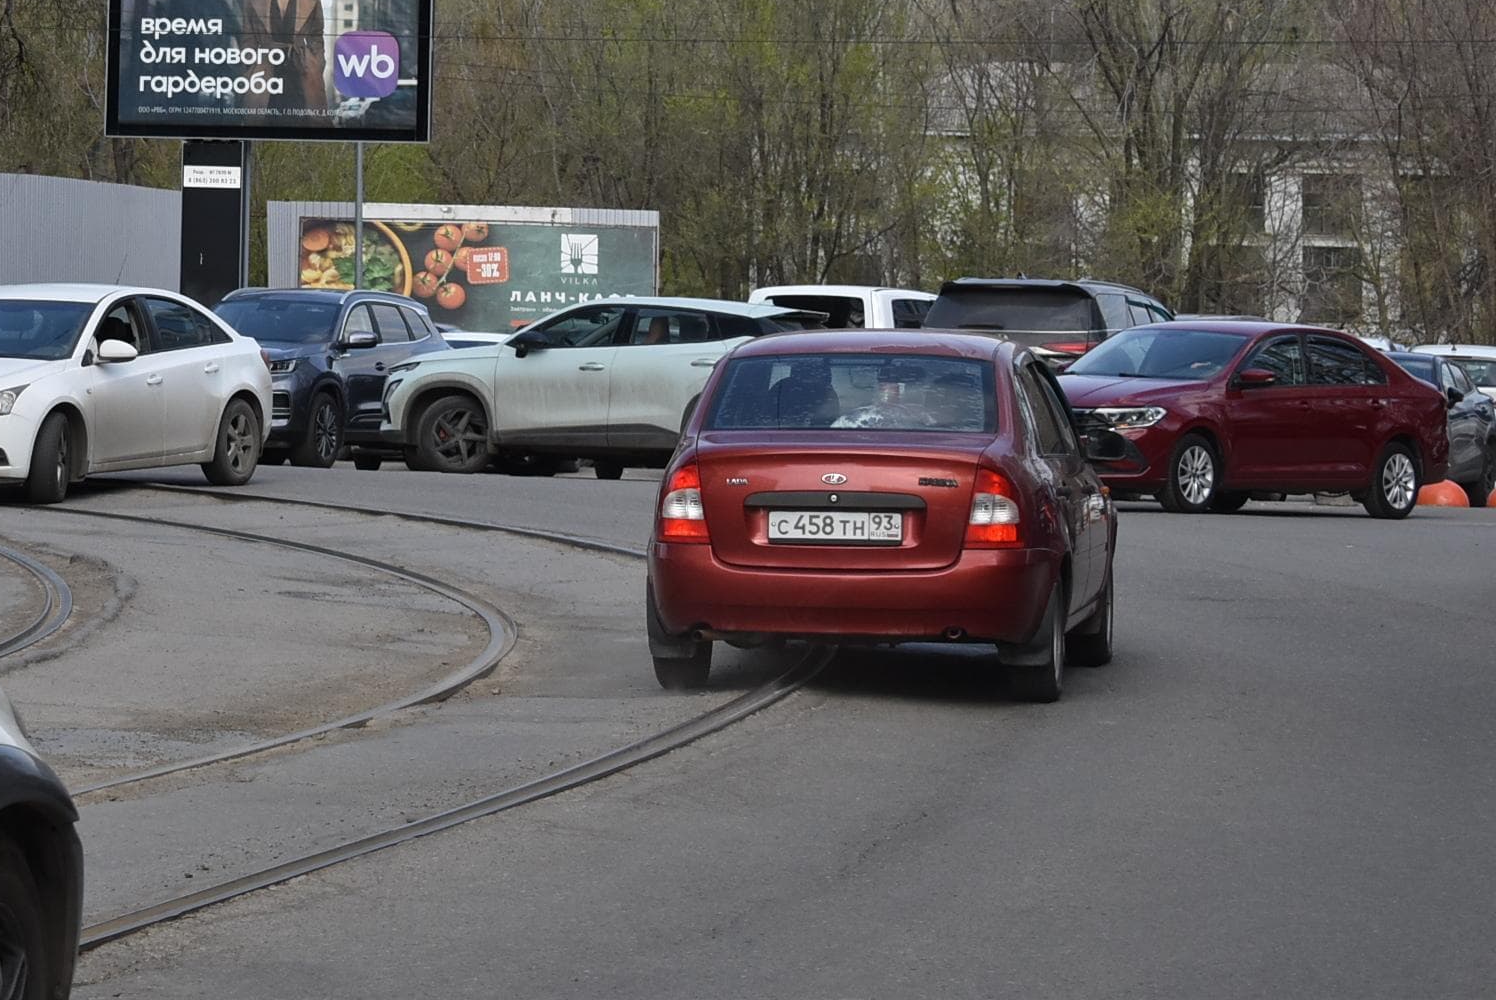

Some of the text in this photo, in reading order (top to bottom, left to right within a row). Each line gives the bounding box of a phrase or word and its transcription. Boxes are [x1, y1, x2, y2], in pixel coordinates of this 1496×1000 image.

[140, 17, 223, 40] время
[139, 40, 286, 65] для нового
[337, 44, 395, 79] wb
[138, 70, 284, 98] гардероба
[510, 290, 635, 304] ЛАНЧ-КА
[871, 515, 893, 531] 93
